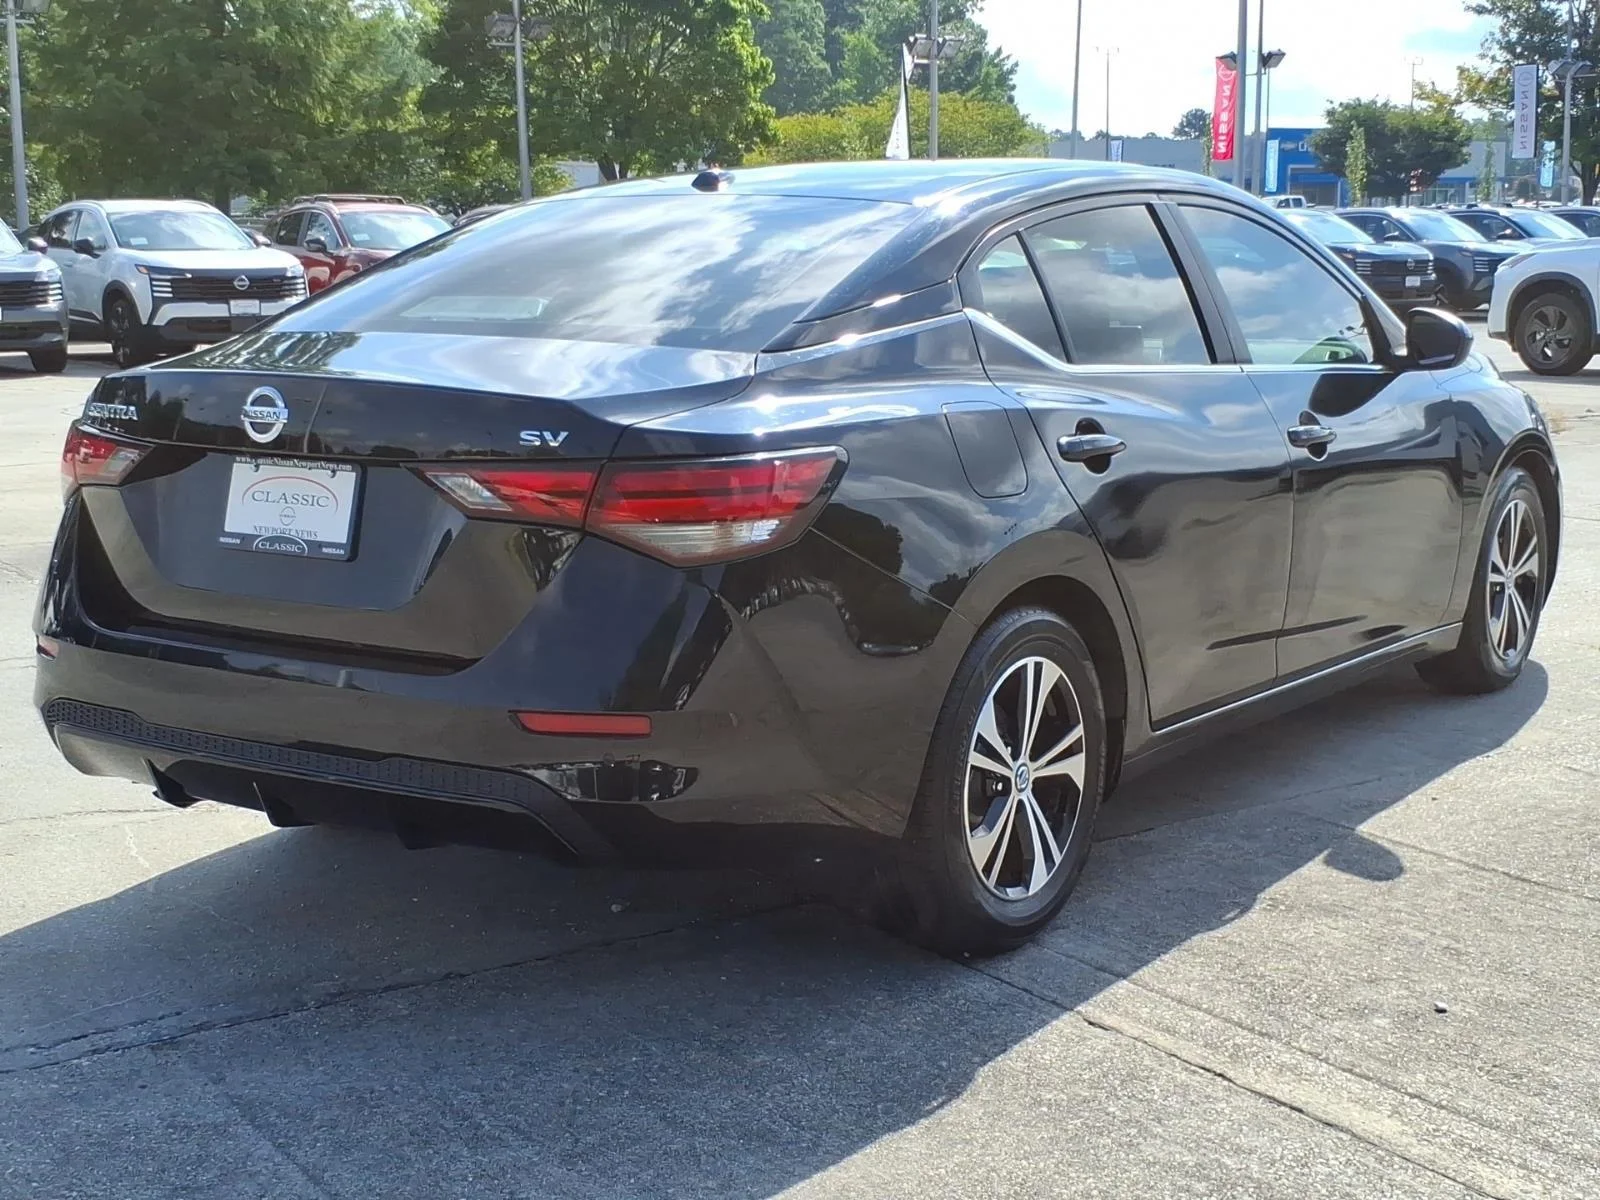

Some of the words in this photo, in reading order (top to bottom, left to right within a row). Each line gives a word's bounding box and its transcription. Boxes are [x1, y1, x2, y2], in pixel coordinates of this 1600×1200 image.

[519, 430, 569, 447] SV
[251, 490, 330, 508] CLASSIC
[258, 541, 303, 553] CLASSIC
